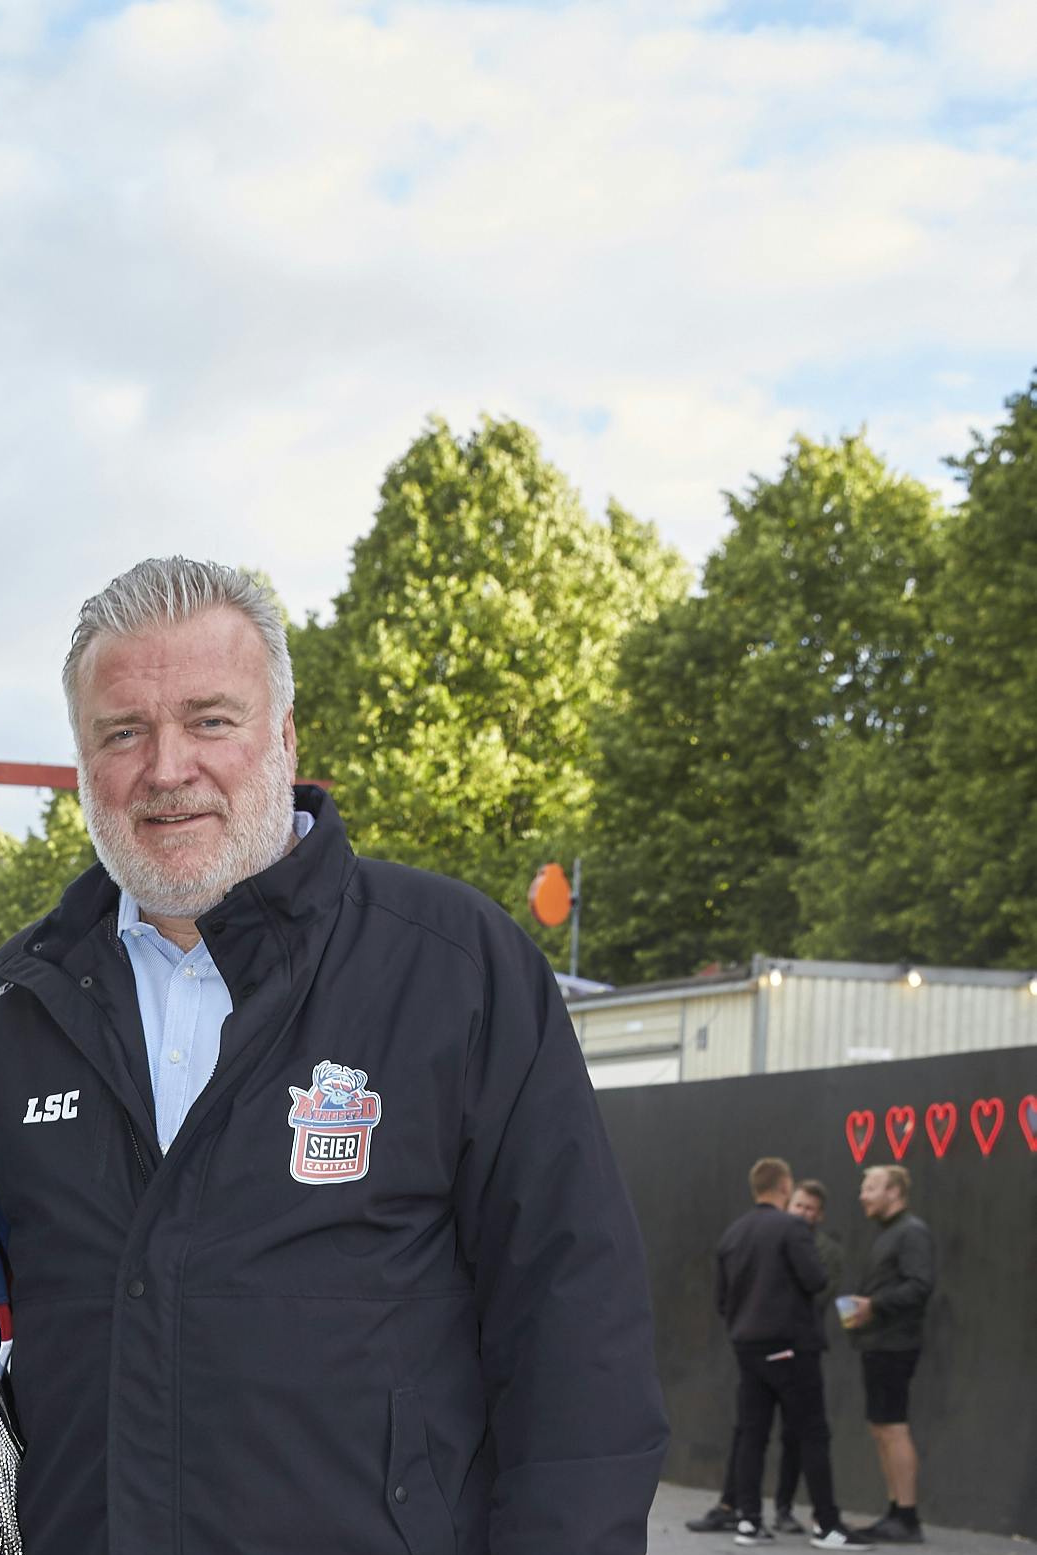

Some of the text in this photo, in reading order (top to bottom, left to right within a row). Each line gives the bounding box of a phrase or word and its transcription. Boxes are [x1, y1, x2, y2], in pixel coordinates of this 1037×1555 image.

[23, 1090, 80, 1123] LSC
[308, 1136, 356, 1159] SEIER
[306, 1161, 354, 1172] CAPITAL
